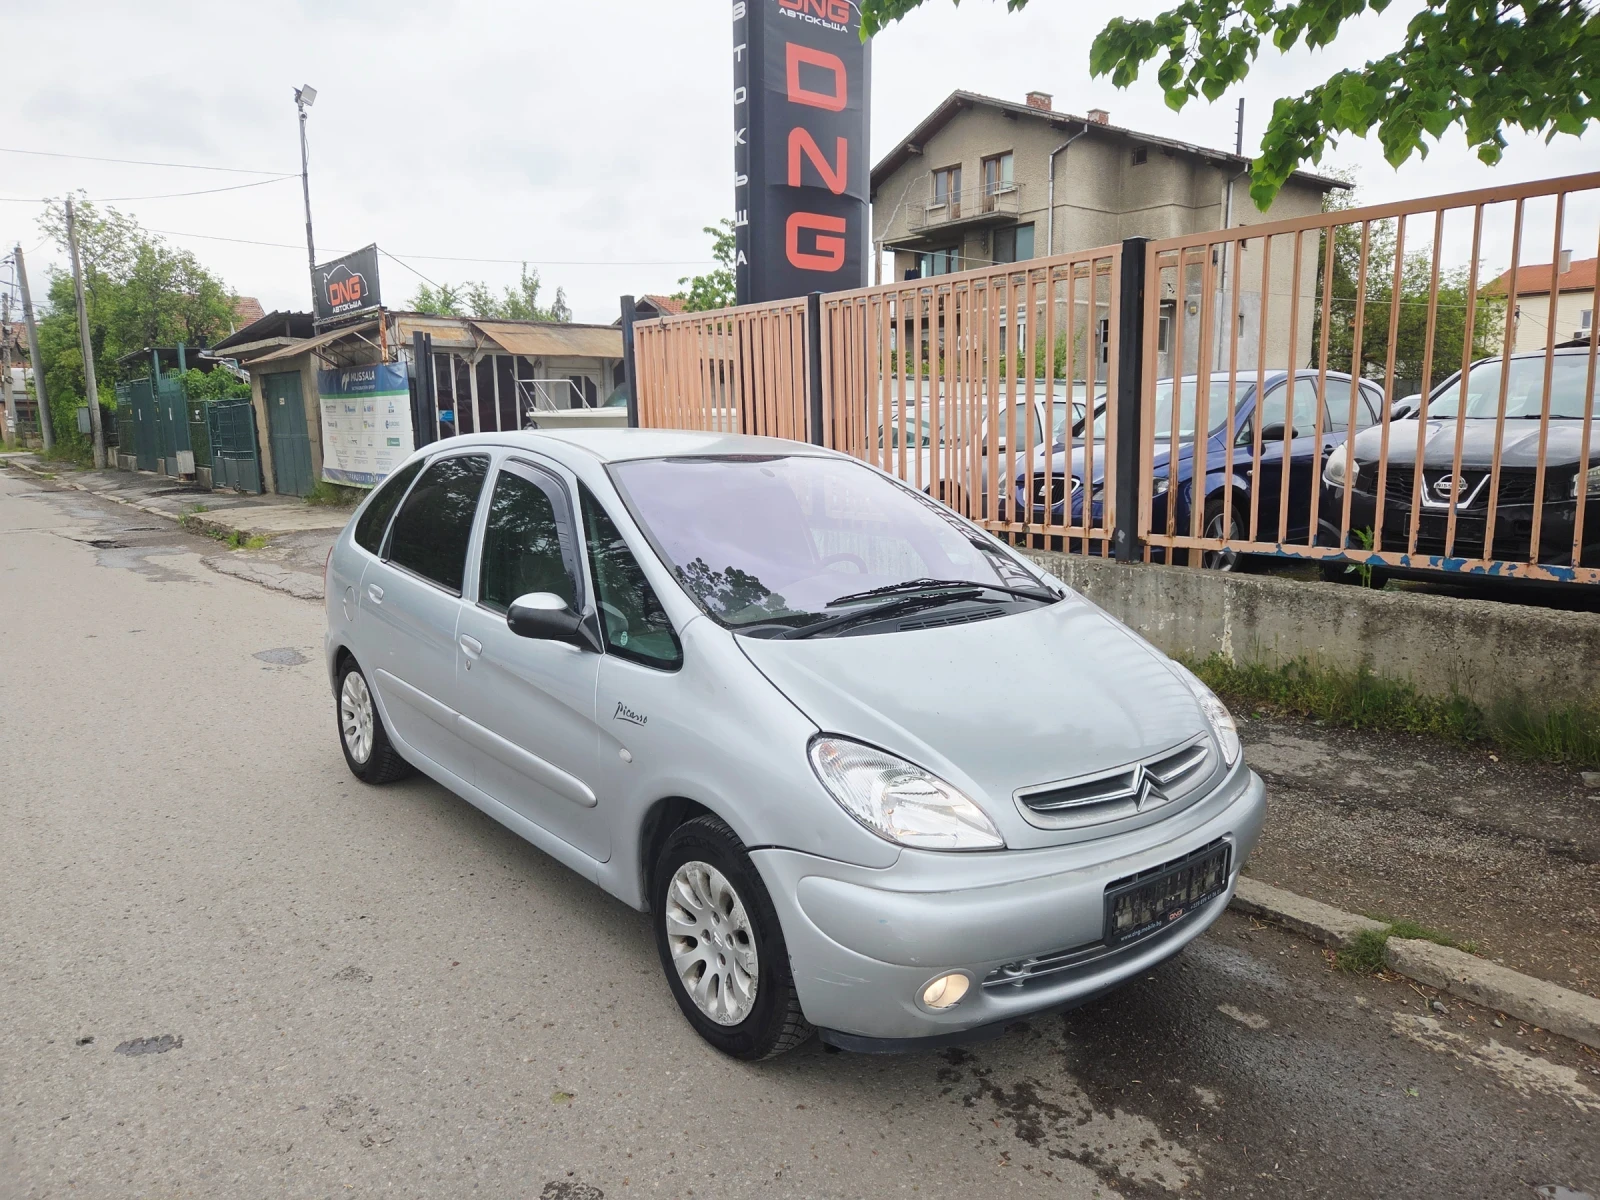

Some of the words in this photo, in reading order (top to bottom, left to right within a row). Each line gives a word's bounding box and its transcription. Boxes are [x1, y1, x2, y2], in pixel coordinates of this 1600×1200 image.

[778, 7, 849, 33] АВТОКЪША
[785, 41, 848, 272] DNG
[329, 275, 361, 306] DNG
[332, 299, 363, 314] АВТОКЪША
[350, 370, 376, 382] MUSSALA
[612, 701, 648, 726] Picasso
